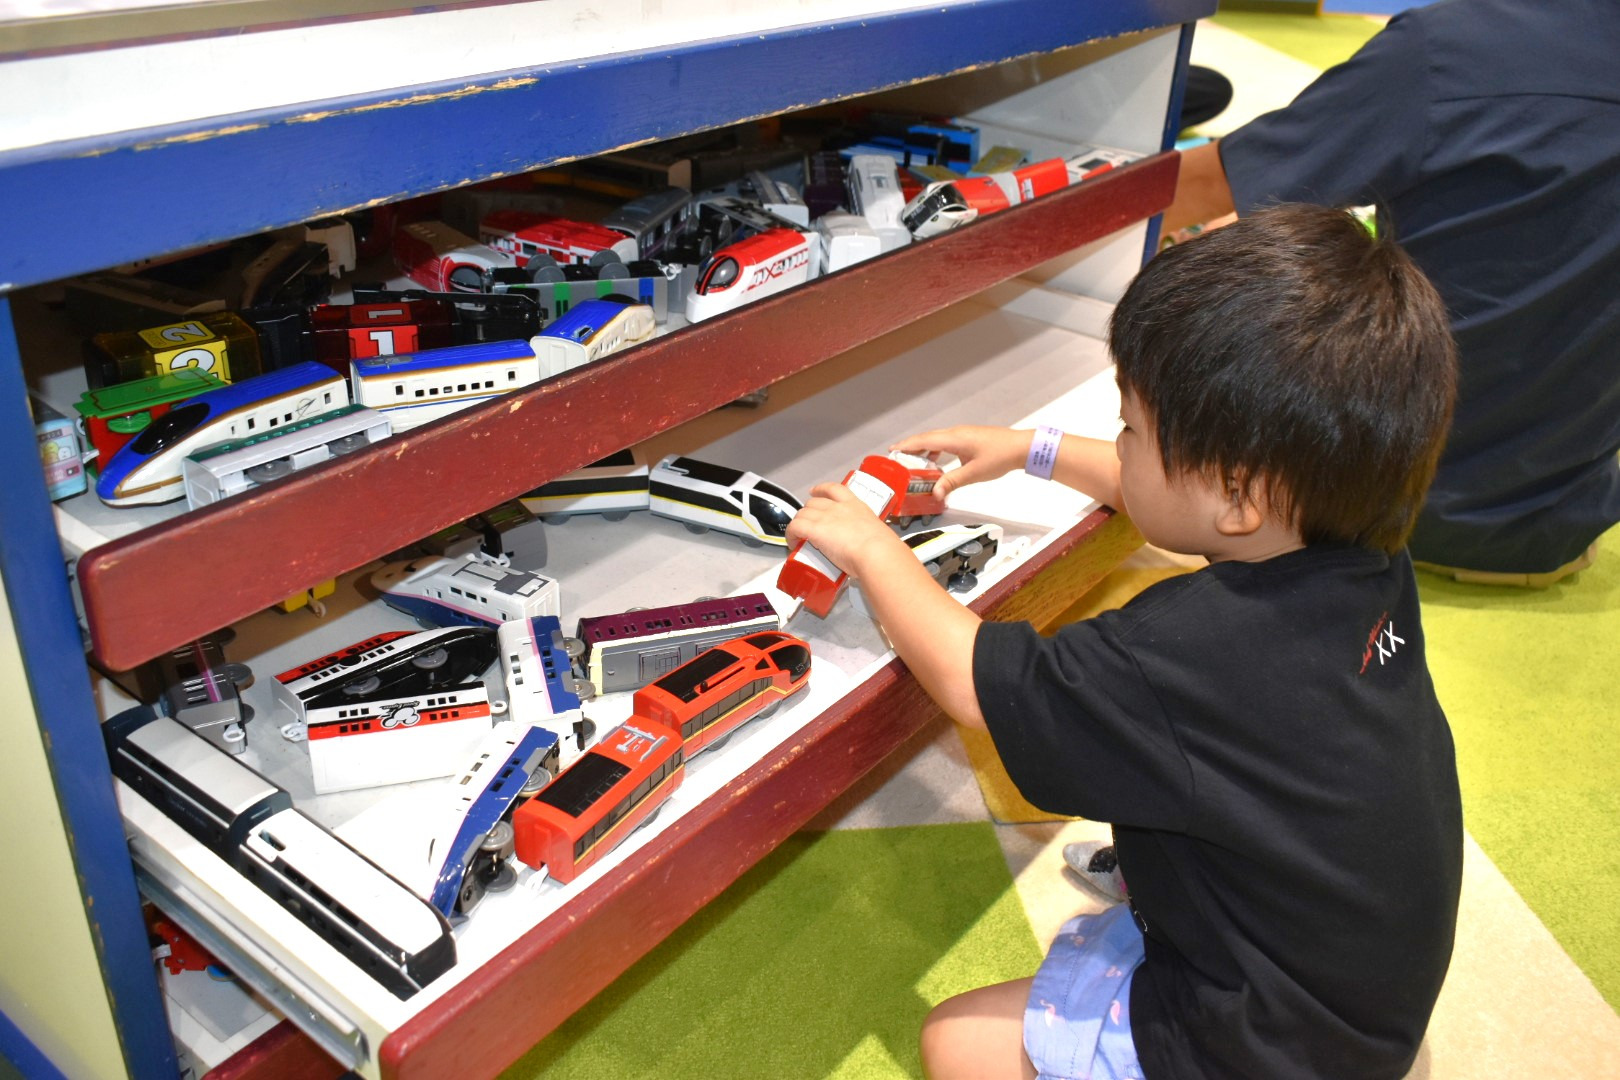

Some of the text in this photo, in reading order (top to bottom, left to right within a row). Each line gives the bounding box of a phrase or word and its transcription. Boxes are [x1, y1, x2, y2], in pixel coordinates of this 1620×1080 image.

[368, 309, 403, 319] 1
[161, 323, 208, 342] 2
[369, 330, 395, 356] 1
